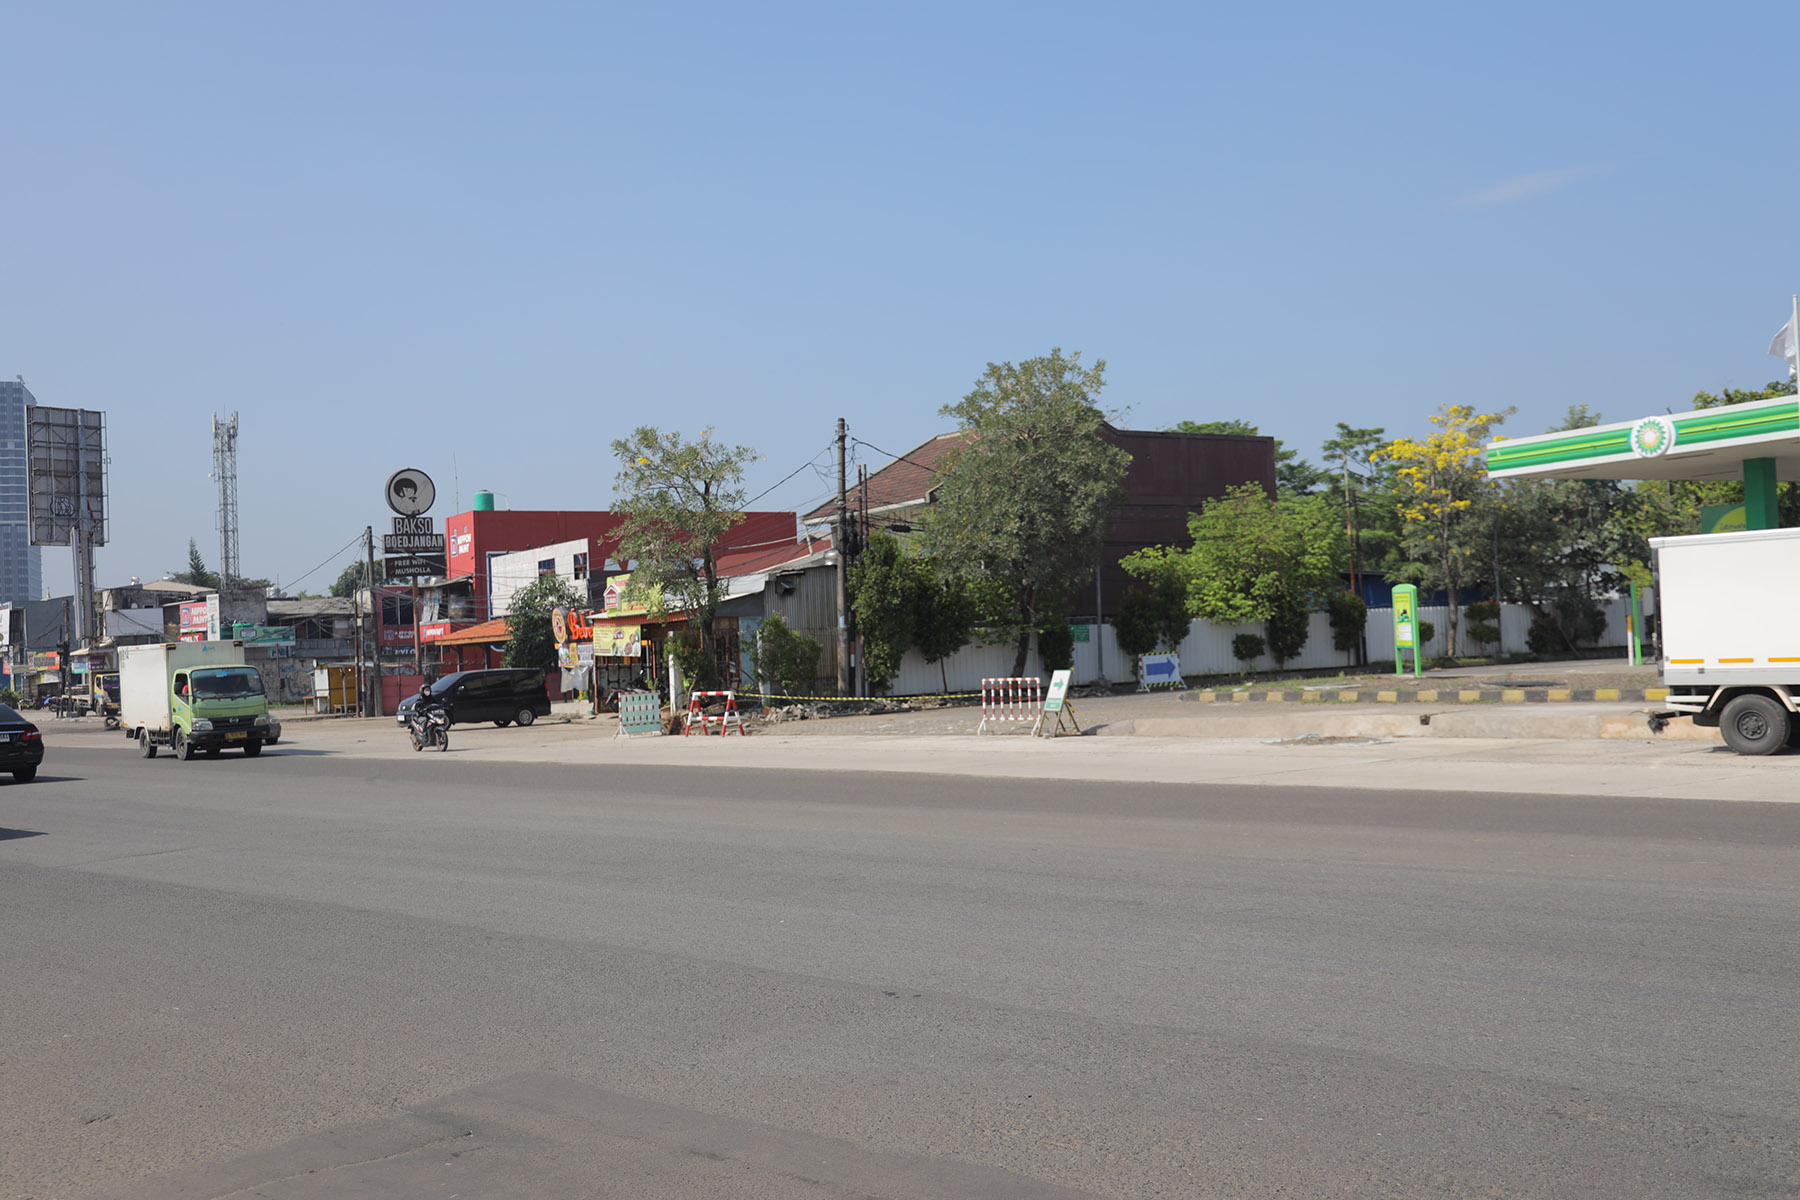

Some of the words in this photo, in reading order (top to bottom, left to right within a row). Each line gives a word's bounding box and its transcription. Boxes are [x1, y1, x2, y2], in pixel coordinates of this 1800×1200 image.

[395, 518, 432, 534] BAKSO
[385, 535, 443, 548] BOEDJANGAN
[394, 559, 410, 567] FREE
[395, 567, 431, 575] MUSHOLLA
[191, 606, 208, 616] NIPPO
